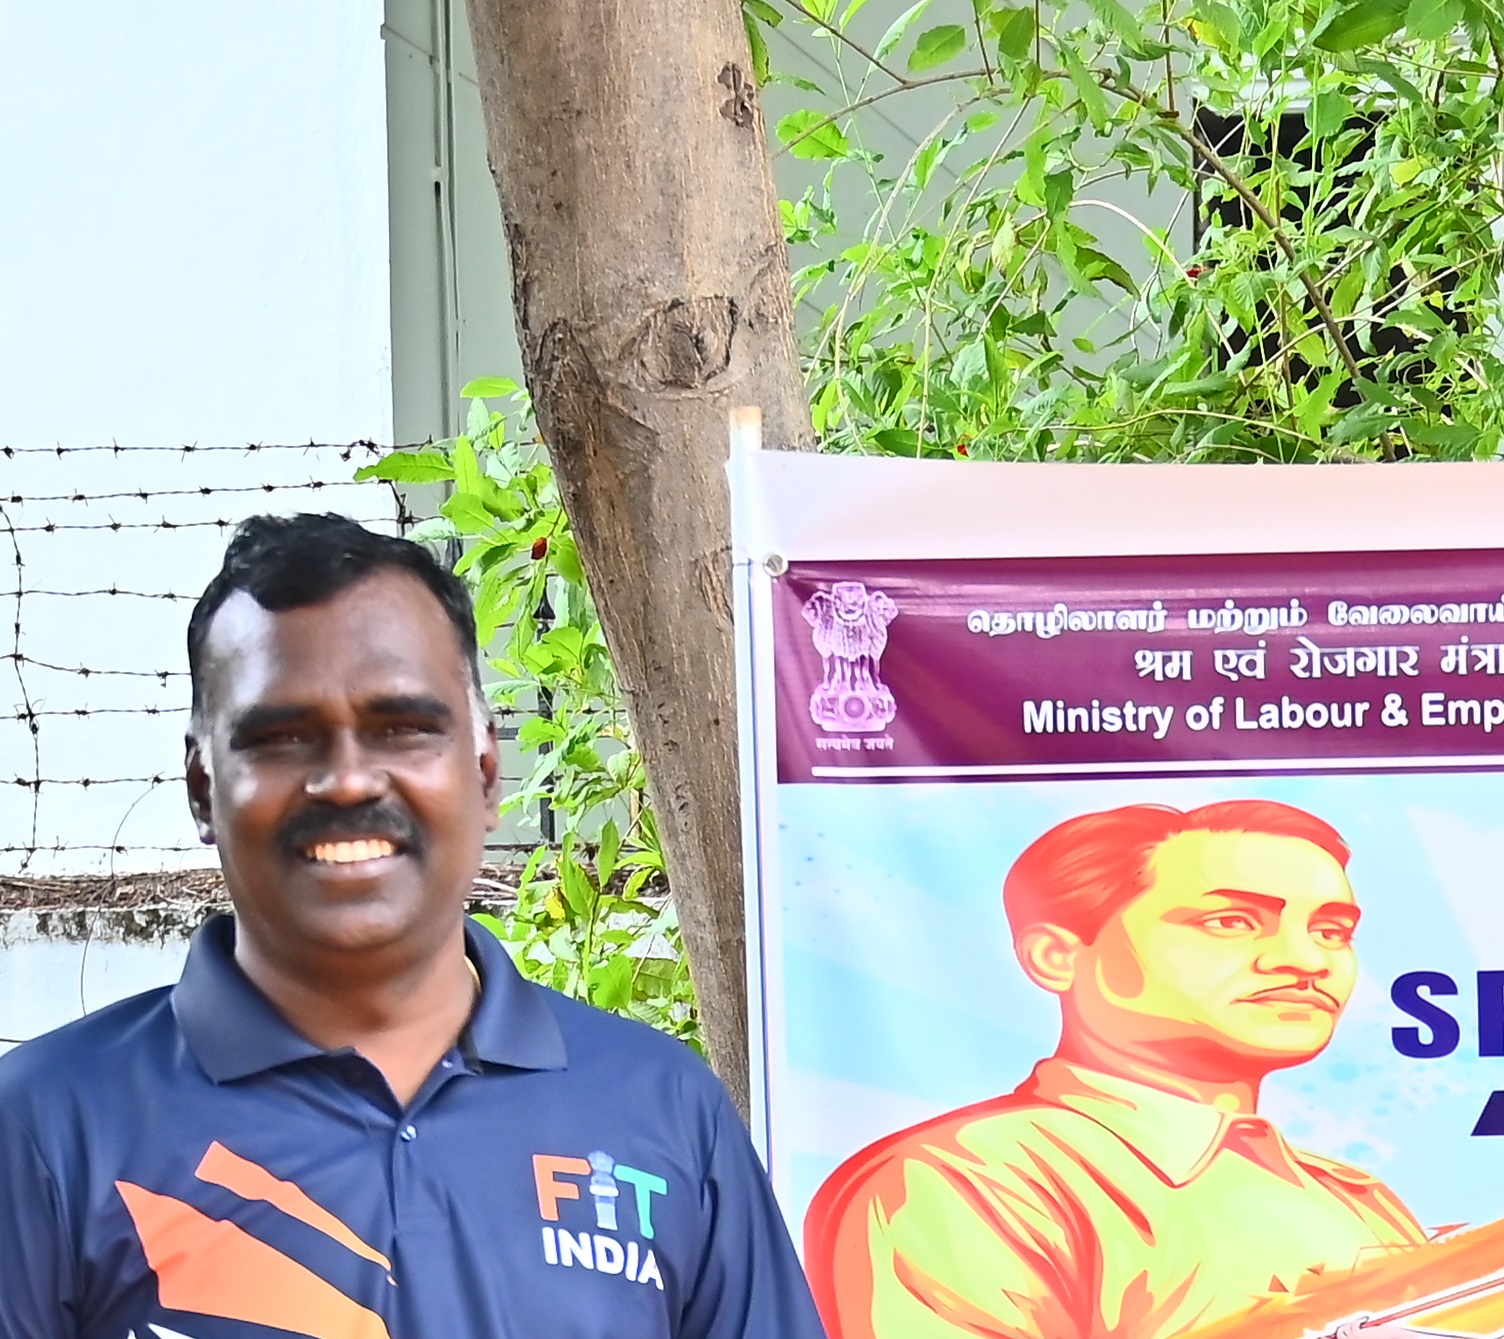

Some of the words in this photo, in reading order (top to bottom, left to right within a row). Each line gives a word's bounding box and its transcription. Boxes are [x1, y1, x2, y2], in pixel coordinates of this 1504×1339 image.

[968, 601, 1167, 638] தொழிலாளர்
[1188, 599, 1307, 635] மற்றும்
[1135, 651, 1192, 680] श्रम
[1214, 640, 1265, 680] एवं
[1291, 637, 1418, 677] रोजगार
[1024, 700, 1173, 738] Ministry
[1186, 697, 1224, 730] of
[1236, 697, 1369, 728] Labour
[1382, 694, 1408, 726] &
[541, 1226, 666, 1291] INDIA
